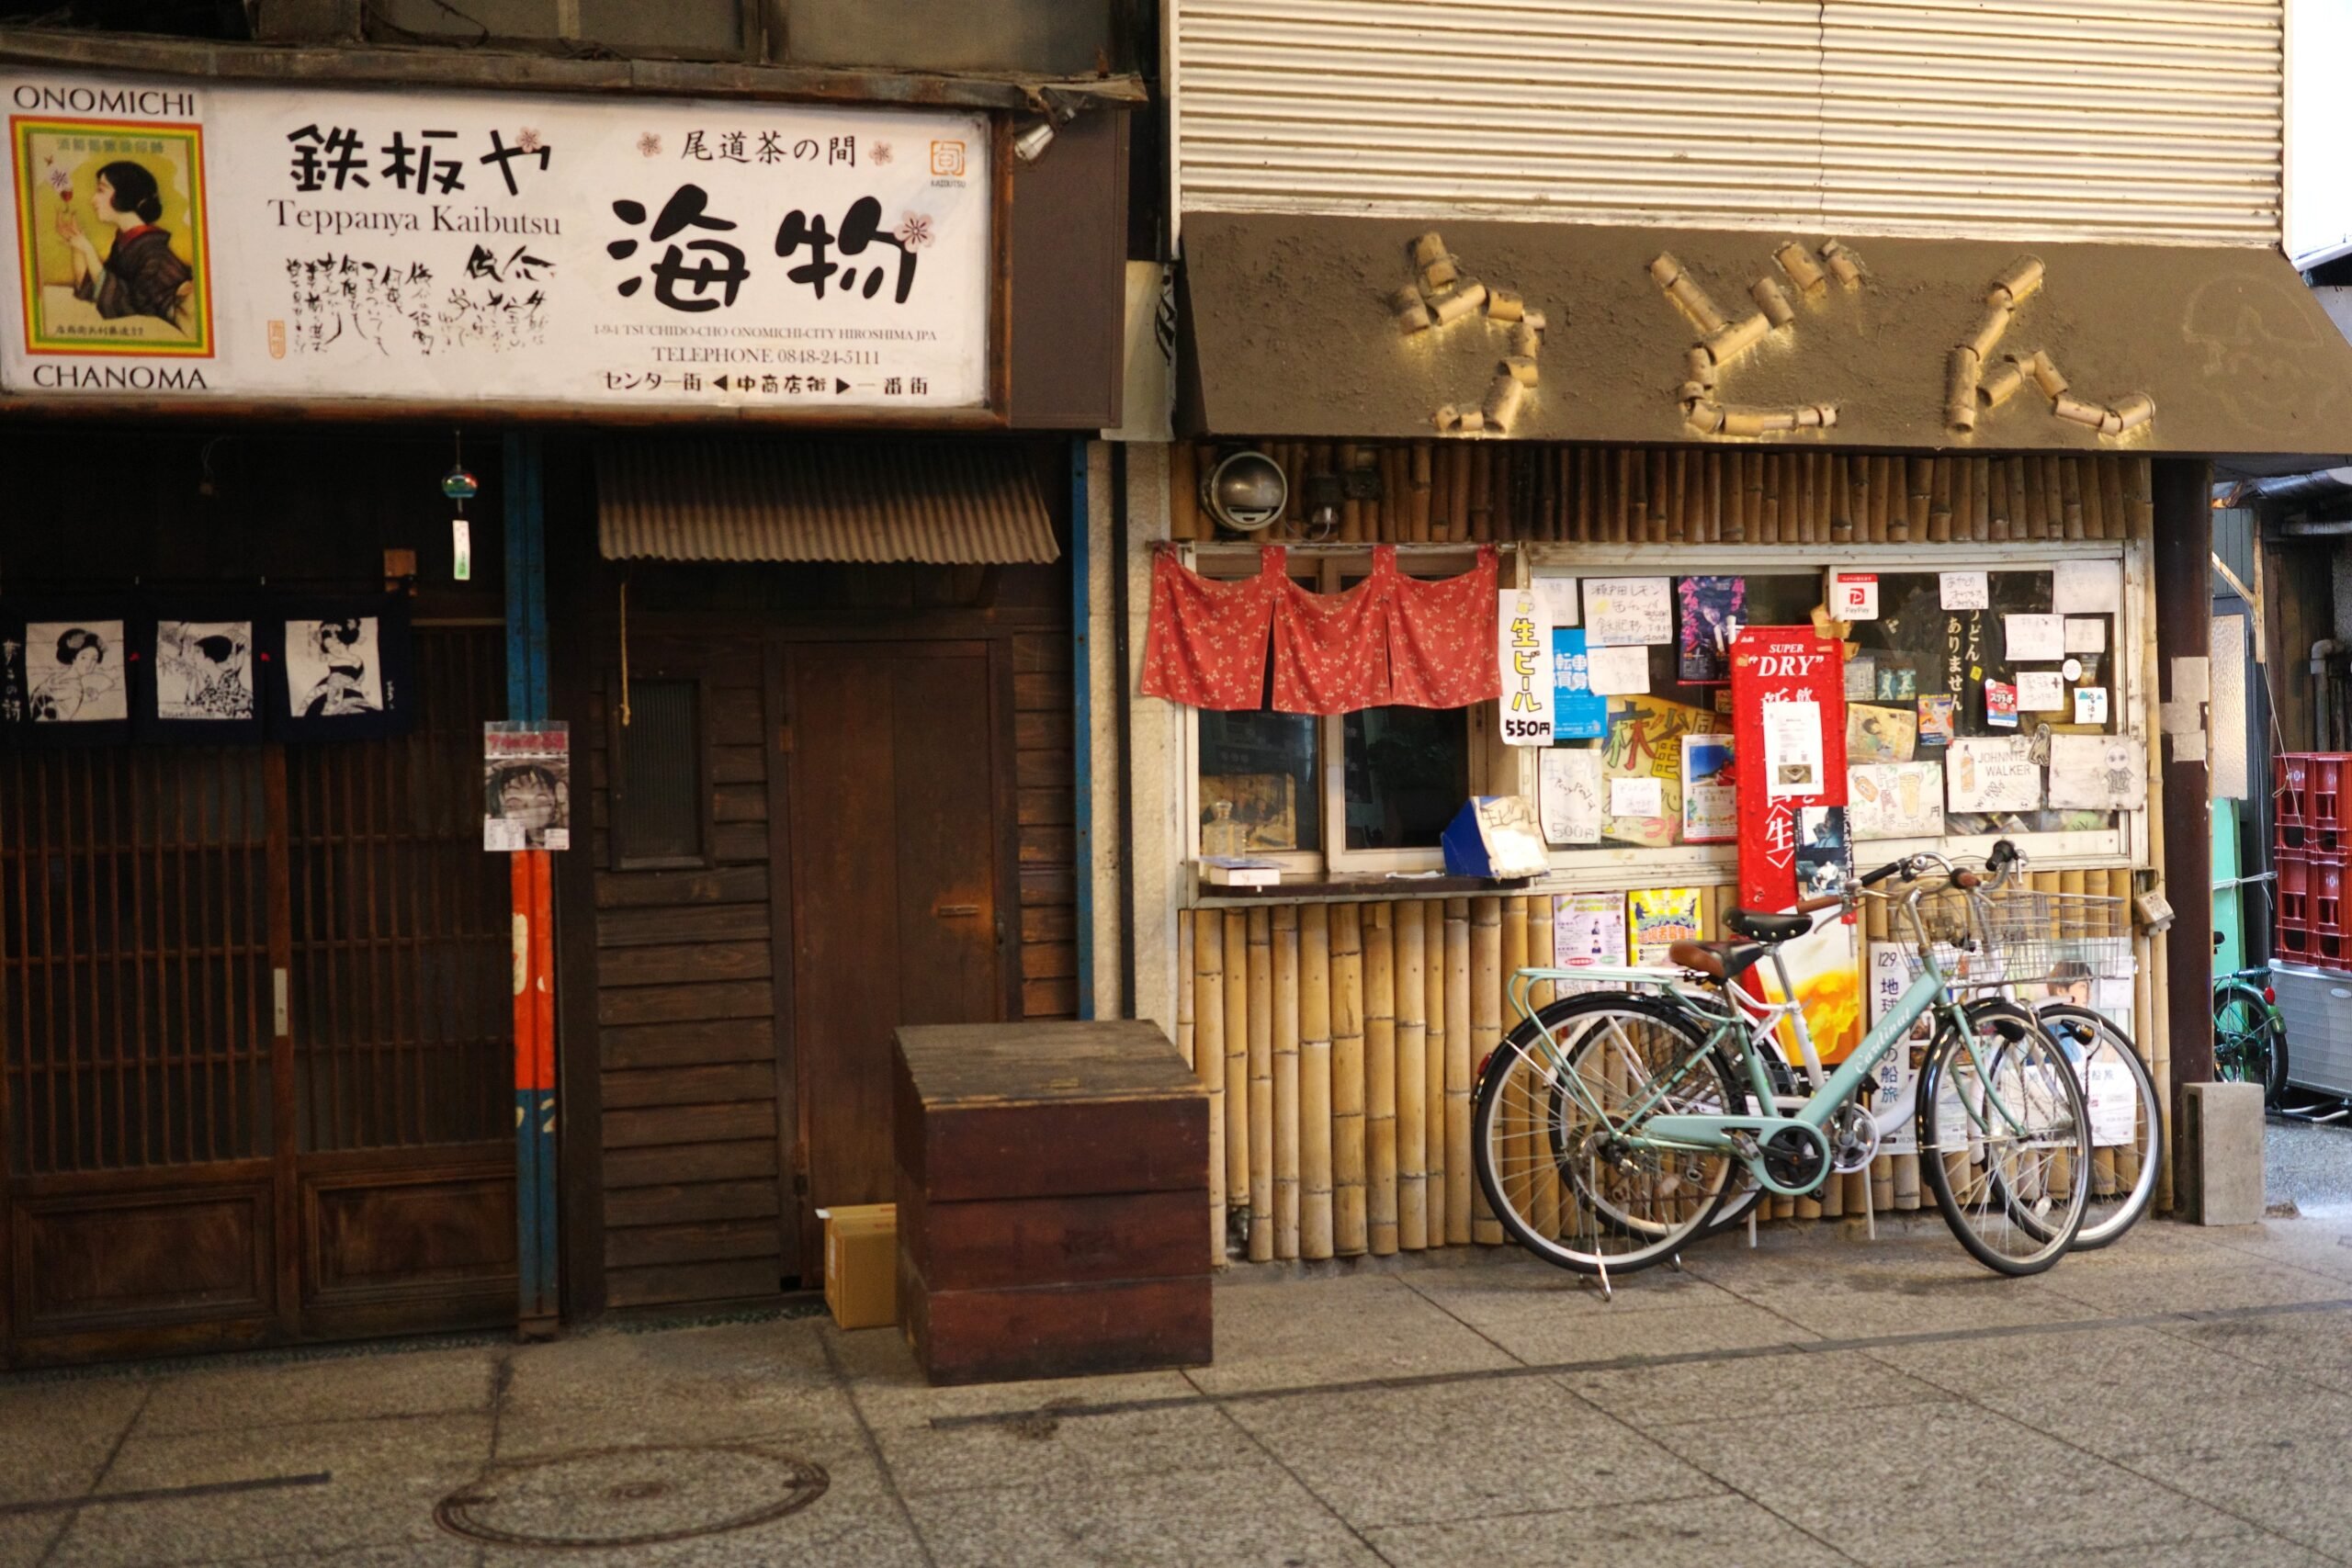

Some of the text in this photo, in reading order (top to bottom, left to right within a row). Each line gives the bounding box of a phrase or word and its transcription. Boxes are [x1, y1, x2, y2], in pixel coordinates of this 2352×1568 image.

[14, 85, 194, 116] ONOMICHI
[287, 124, 551, 196] 鉄板や
[681, 130, 856, 167] 尾道茶の間
[267, 198, 561, 236] Teppanya Kaibutsu
[606, 184, 918, 312] 海物
[622, 324, 728, 337] TSUCHIDO-CHO
[731, 326, 837, 339] ONOMICHI-CITY
[839, 328, 914, 341] HIROSHIMA
[915, 331, 937, 343] JPA
[1395, 231, 2156, 435] うどん
[651, 346, 879, 366] TELEPHONE 0848-24-5111
[33, 365, 208, 389] CHANOMA
[604, 371, 928, 395] センター街 中商店街 一番街
[1769, 644, 1804, 653] SUPER
[1511, 617, 1542, 713] 生ビール
[1947, 617, 1963, 712] ありません
[1505, 719, 1551, 737] 550円
[1985, 763, 2032, 777] WALKER
[1553, 822, 1596, 839] 500円
[1878, 951, 1899, 968] 129
[1854, 1009, 1911, 1075] Cardinal
